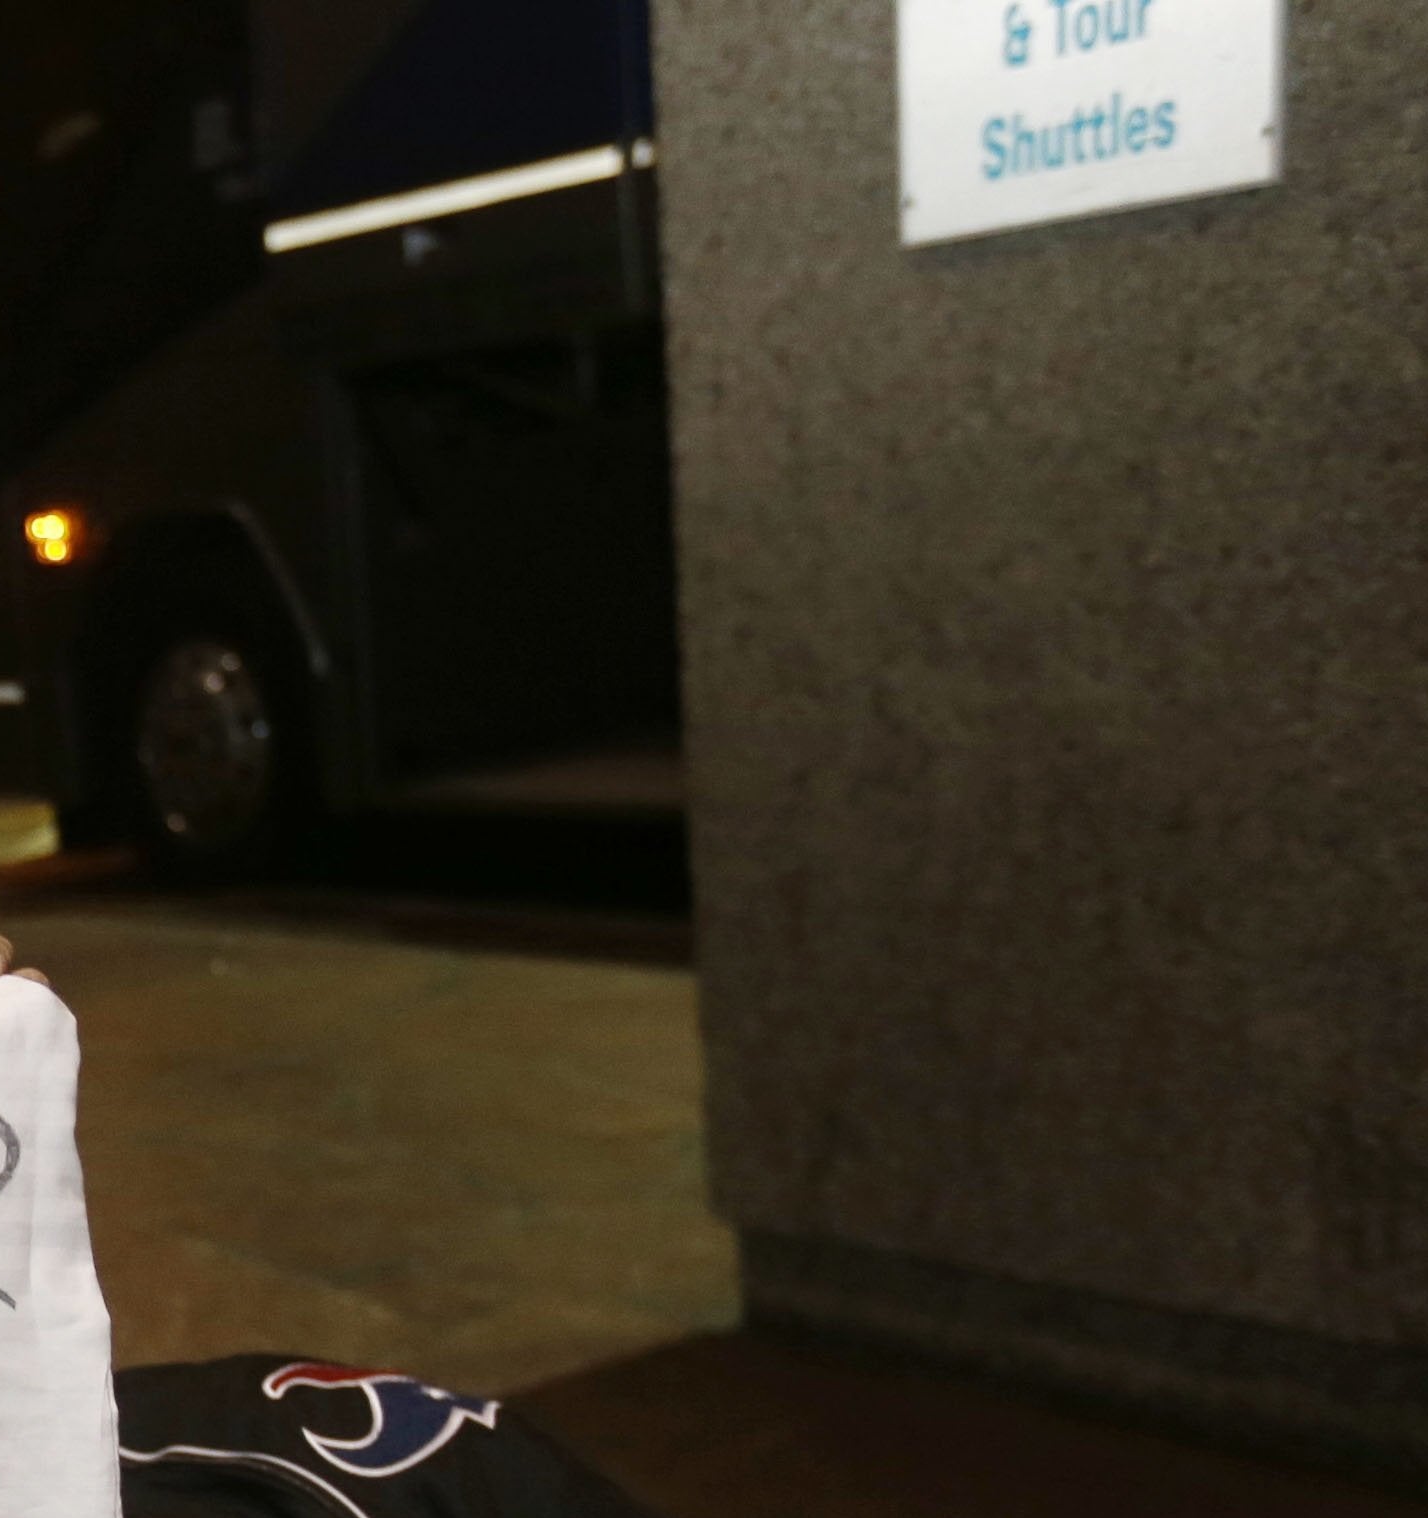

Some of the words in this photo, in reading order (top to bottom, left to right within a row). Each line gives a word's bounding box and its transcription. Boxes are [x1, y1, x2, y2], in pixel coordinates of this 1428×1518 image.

[1002, 2, 1032, 68] &
[1050, 0, 1152, 57] Tour
[981, 94, 1177, 181] Shuttles
